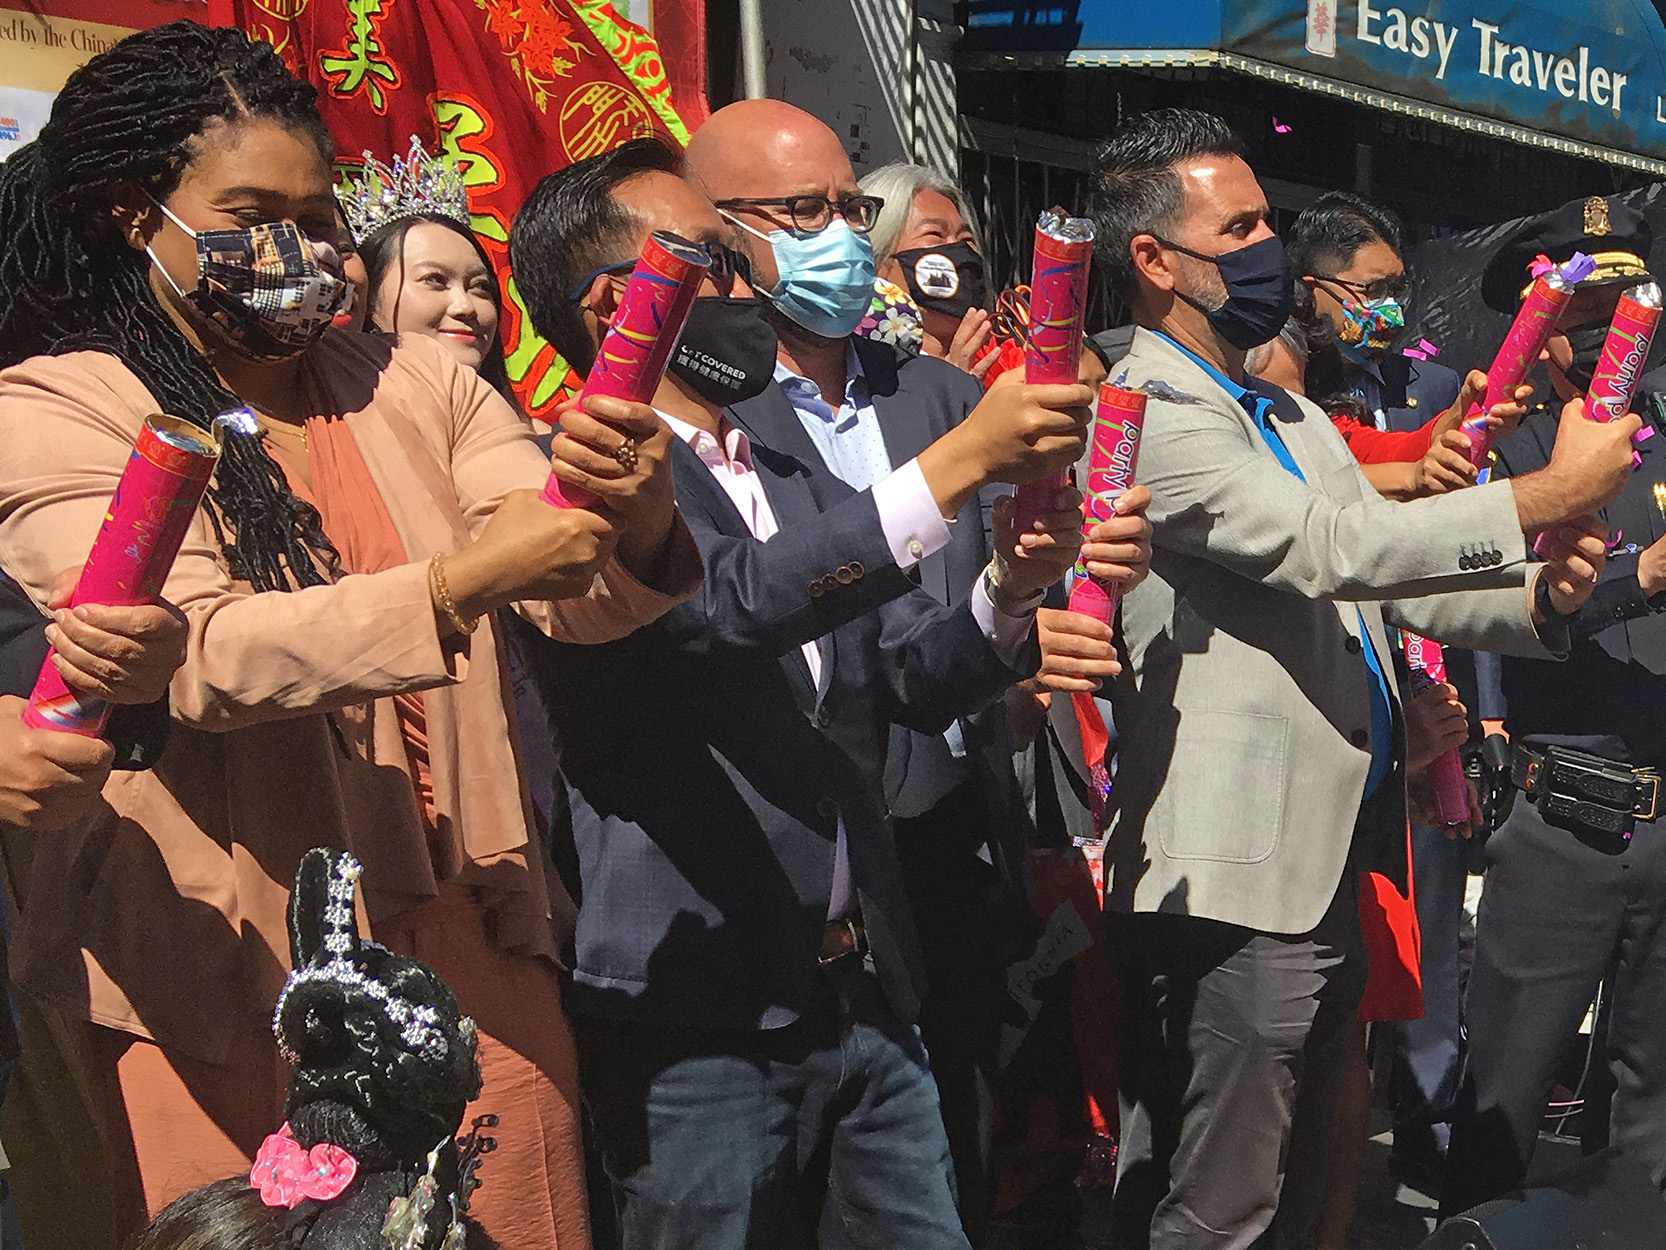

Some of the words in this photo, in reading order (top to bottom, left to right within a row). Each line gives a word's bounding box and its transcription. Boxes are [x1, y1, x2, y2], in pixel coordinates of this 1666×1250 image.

[20, 20, 37, 49] by
[44, 25, 67, 49] the
[1357, 0, 1459, 79] Easy
[1471, 17, 1627, 111] Traveler
[701, 353, 747, 380] COVERED
[1609, 331, 1649, 401] party
[1102, 419, 1140, 491] party
